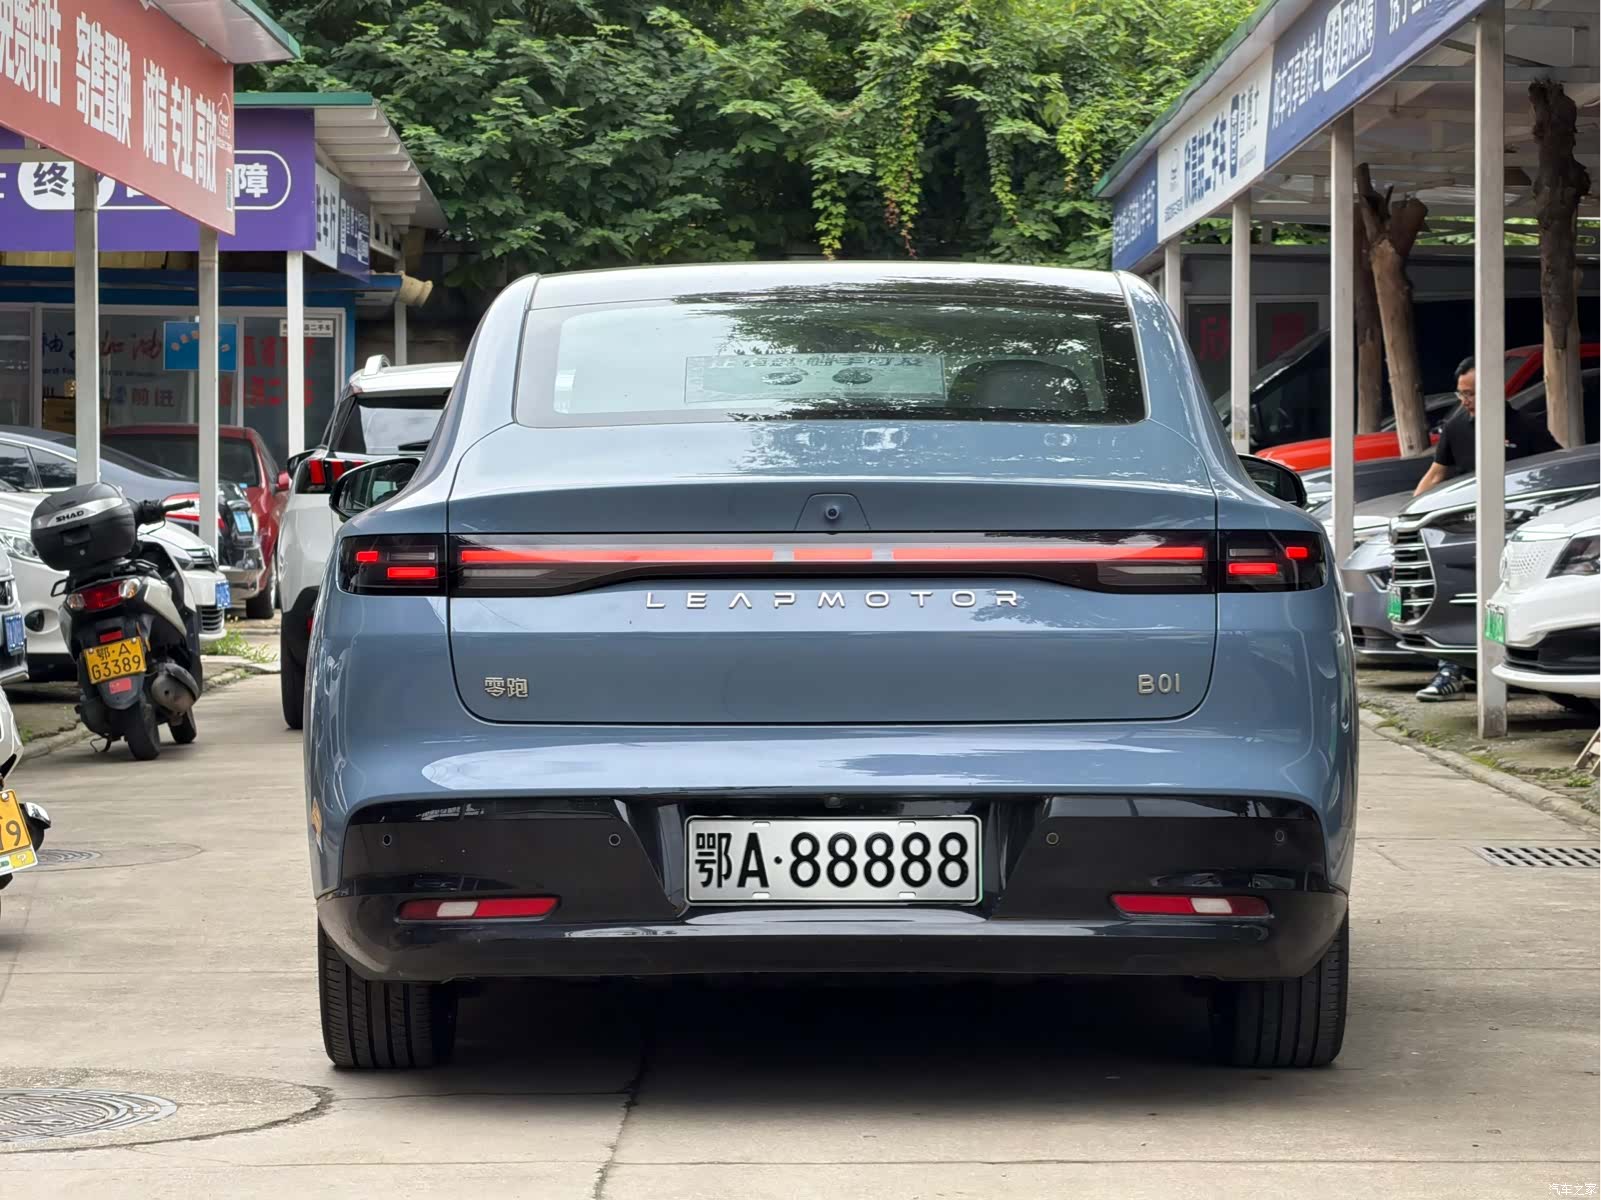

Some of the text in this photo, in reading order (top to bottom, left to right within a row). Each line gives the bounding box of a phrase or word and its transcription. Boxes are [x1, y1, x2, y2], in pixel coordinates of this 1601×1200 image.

[75, 11, 132, 149] 寄售置换
[55, 510, 85, 523] SHAD
[645, 590, 1019, 609] LEAPMOTOR
[91, 654, 142, 681] G3389
[484, 676, 529, 698] 零跑
